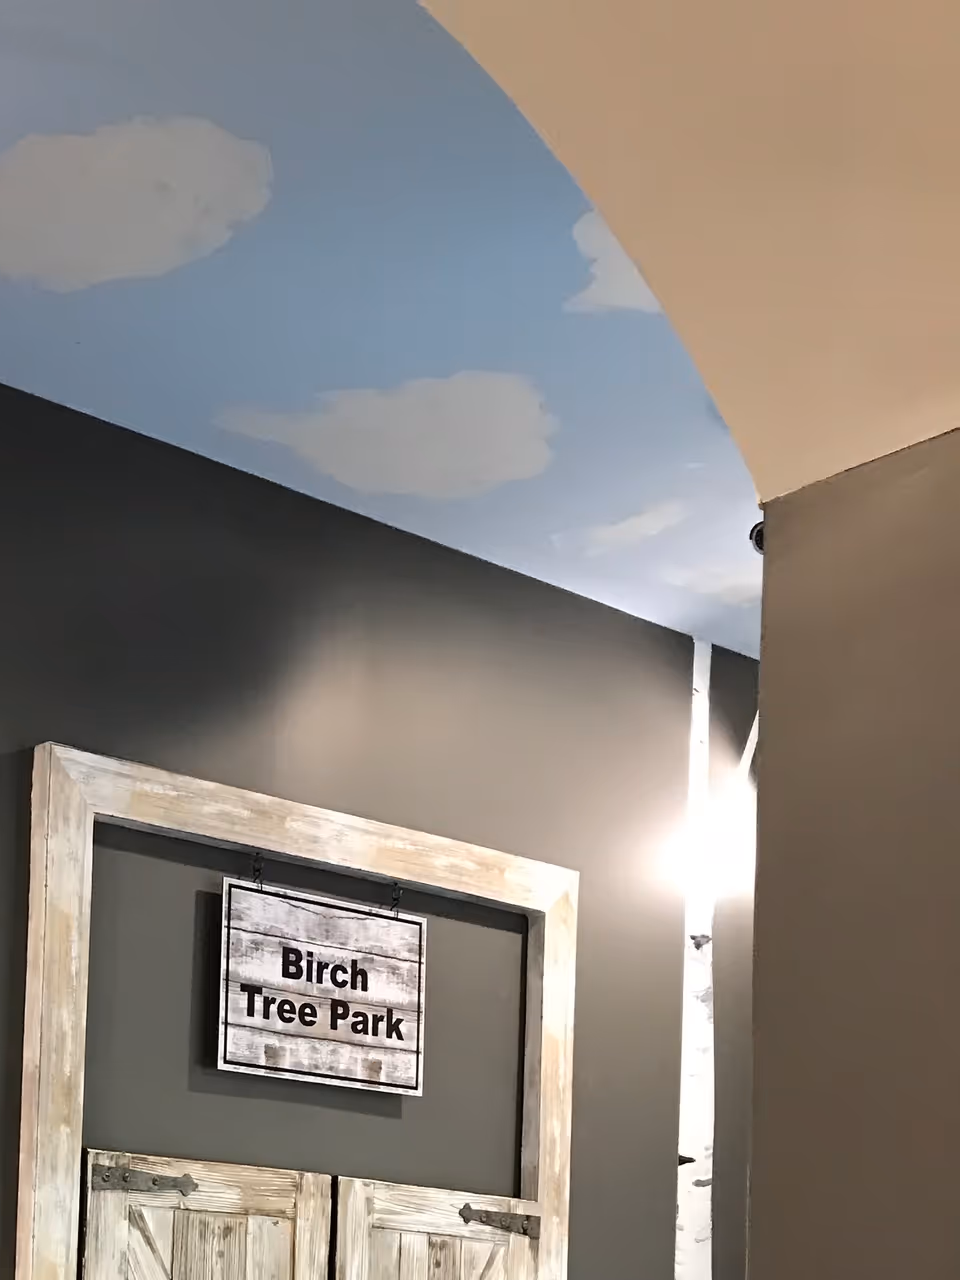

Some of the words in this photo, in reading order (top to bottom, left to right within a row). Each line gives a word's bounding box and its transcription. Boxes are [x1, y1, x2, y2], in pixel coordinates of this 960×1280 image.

[282, 946, 369, 992] Birch
[240, 984, 318, 1027] Tree
[329, 998, 404, 1041] Park
